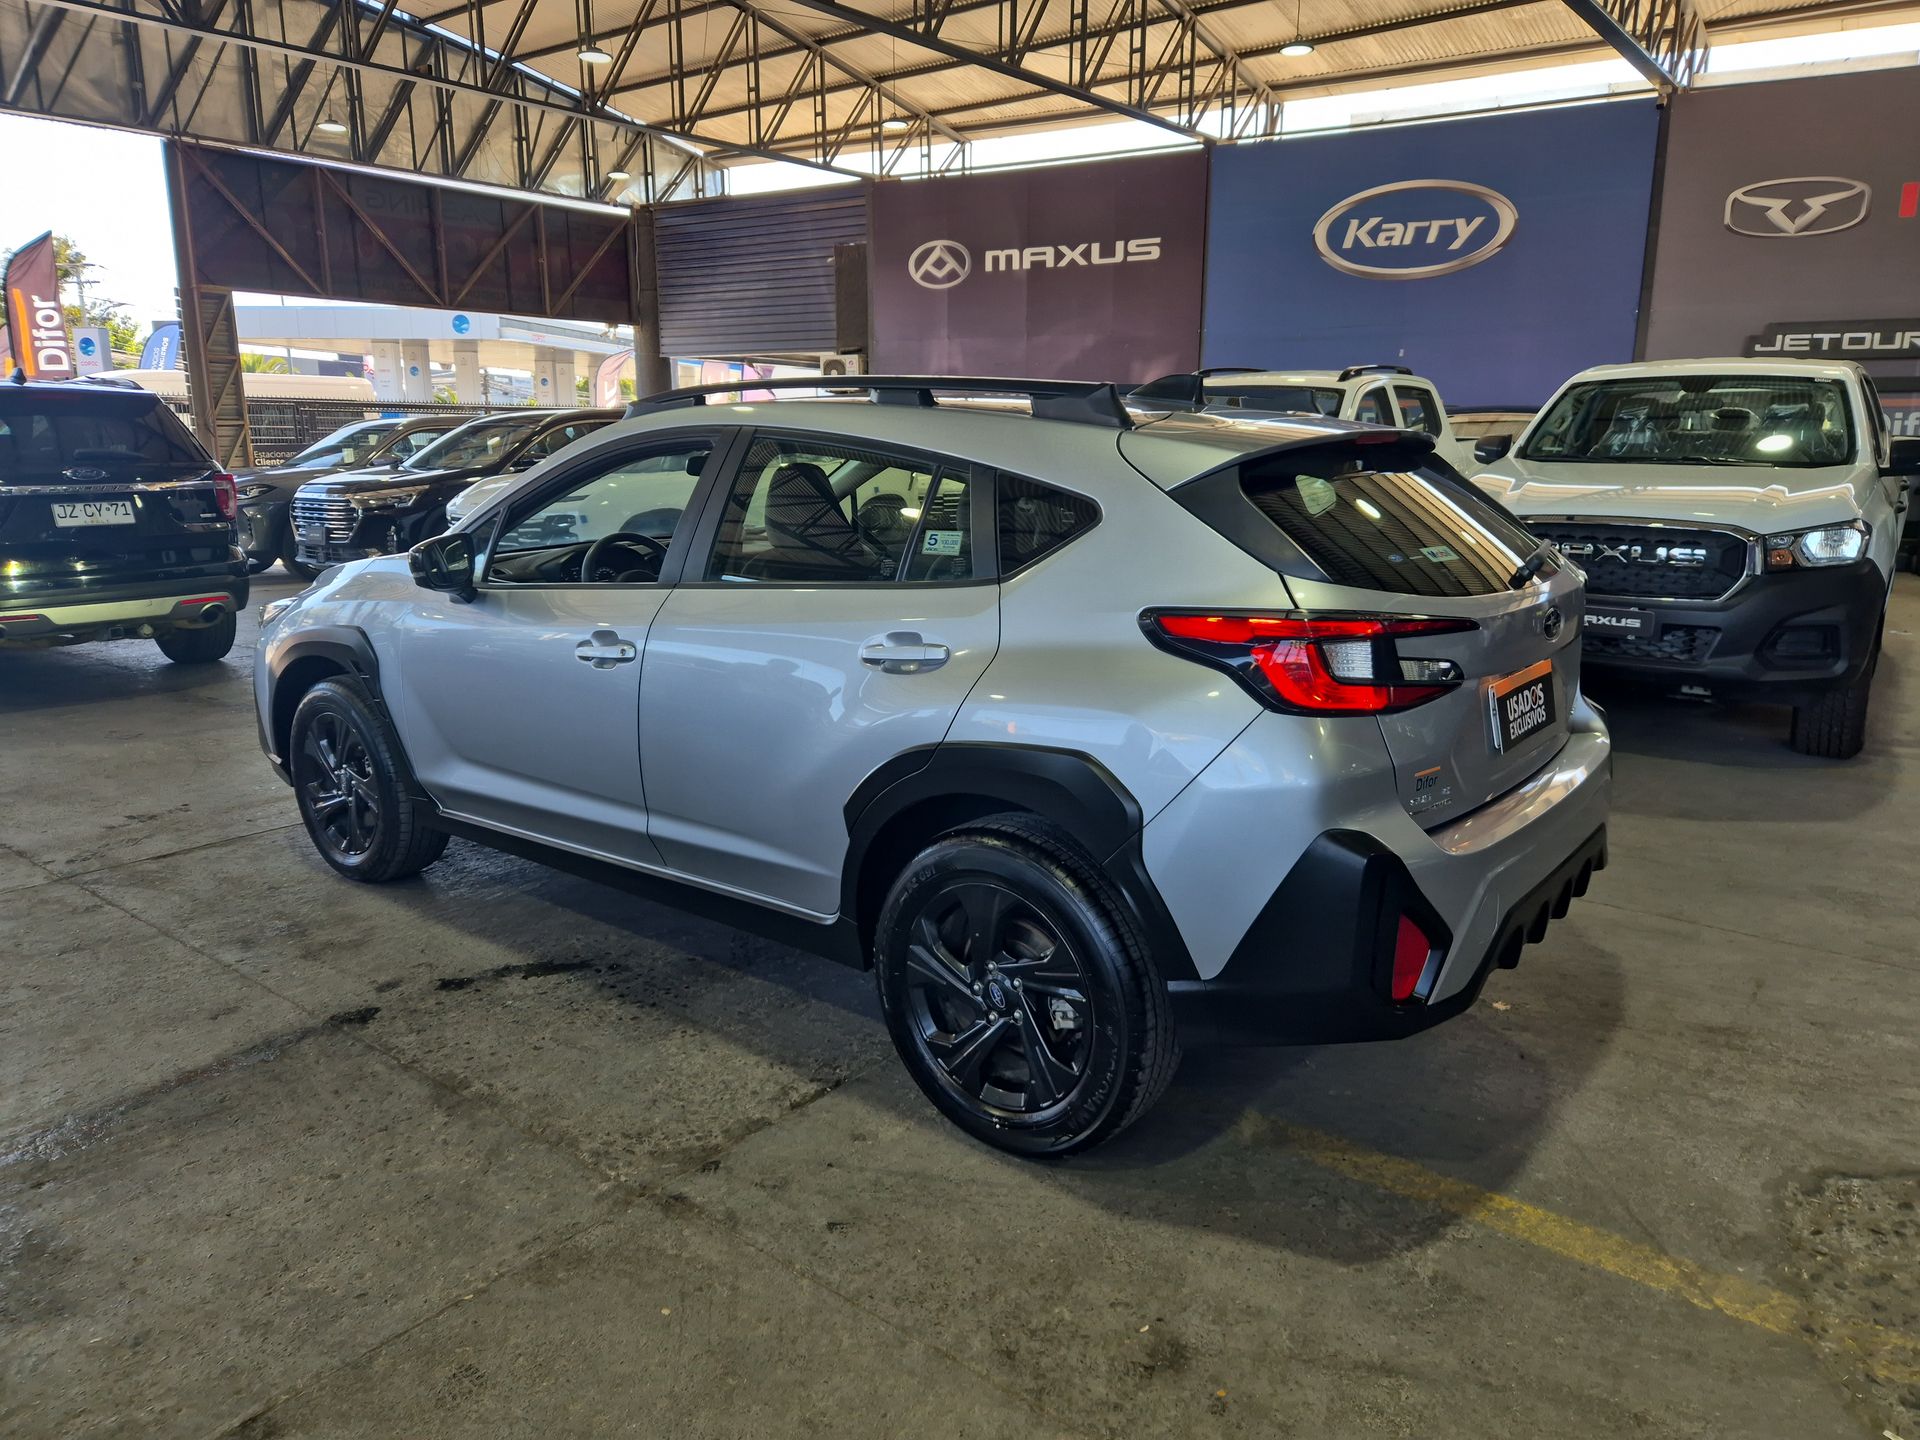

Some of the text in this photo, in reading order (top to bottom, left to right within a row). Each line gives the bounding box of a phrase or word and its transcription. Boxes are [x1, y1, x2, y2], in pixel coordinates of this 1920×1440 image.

[1341, 214, 1487, 250] Karry
[984, 236, 1162, 272] MAXUS
[32, 294, 70, 371] Difor
[928, 534, 938, 546] 5
[1553, 542, 1707, 567] AXUS
[1584, 614, 1641, 628] AXUS
[1506, 682, 1544, 720] USADOS
[1509, 706, 1546, 739] EXCLUSIVOS
[1415, 775, 1439, 792] Difor
